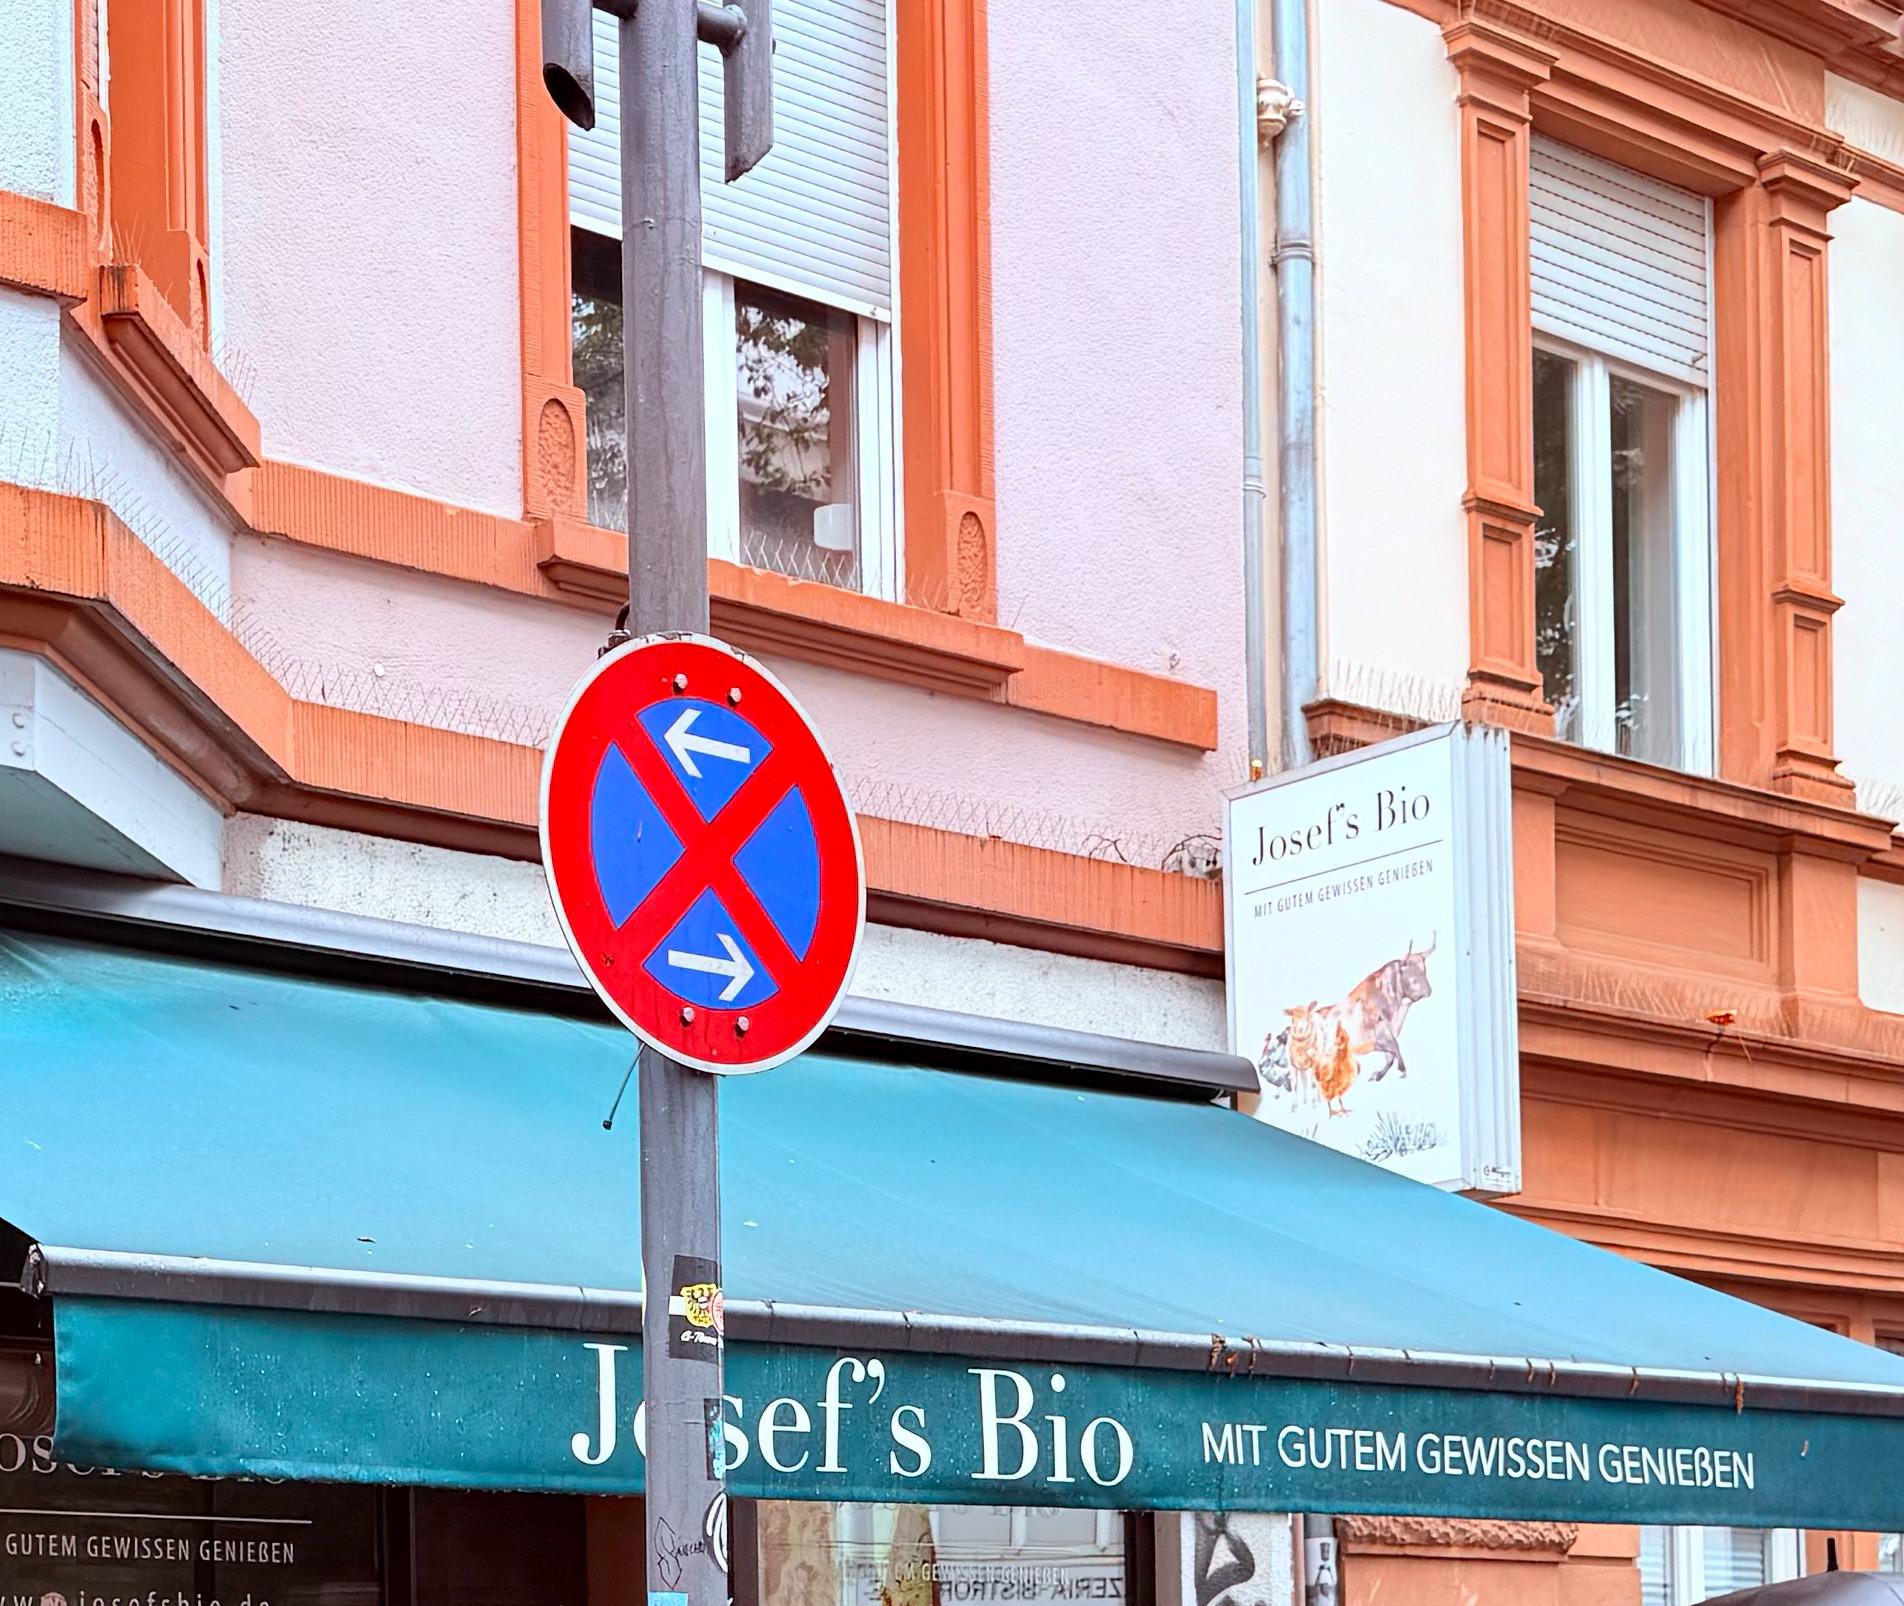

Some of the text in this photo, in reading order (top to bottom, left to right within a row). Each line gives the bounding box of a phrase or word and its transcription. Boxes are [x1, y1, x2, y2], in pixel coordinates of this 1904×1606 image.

[1251, 785, 1431, 867] Josef's Bio
[1254, 898, 1273, 919] MIT
[1277, 891, 1314, 914] GUTEM
[1318, 878, 1374, 905] GEWISSEN
[571, 1342, 1135, 1487] Jsef's Bio
[1201, 1421, 1755, 1490] MIT GUTEM GEWISSEN GENIEßEN
[5, 1533, 77, 1557] GUTEM
[86, 1536, 190, 1561] GEWISSEN
[199, 1540, 295, 1564] GENIEßEN
